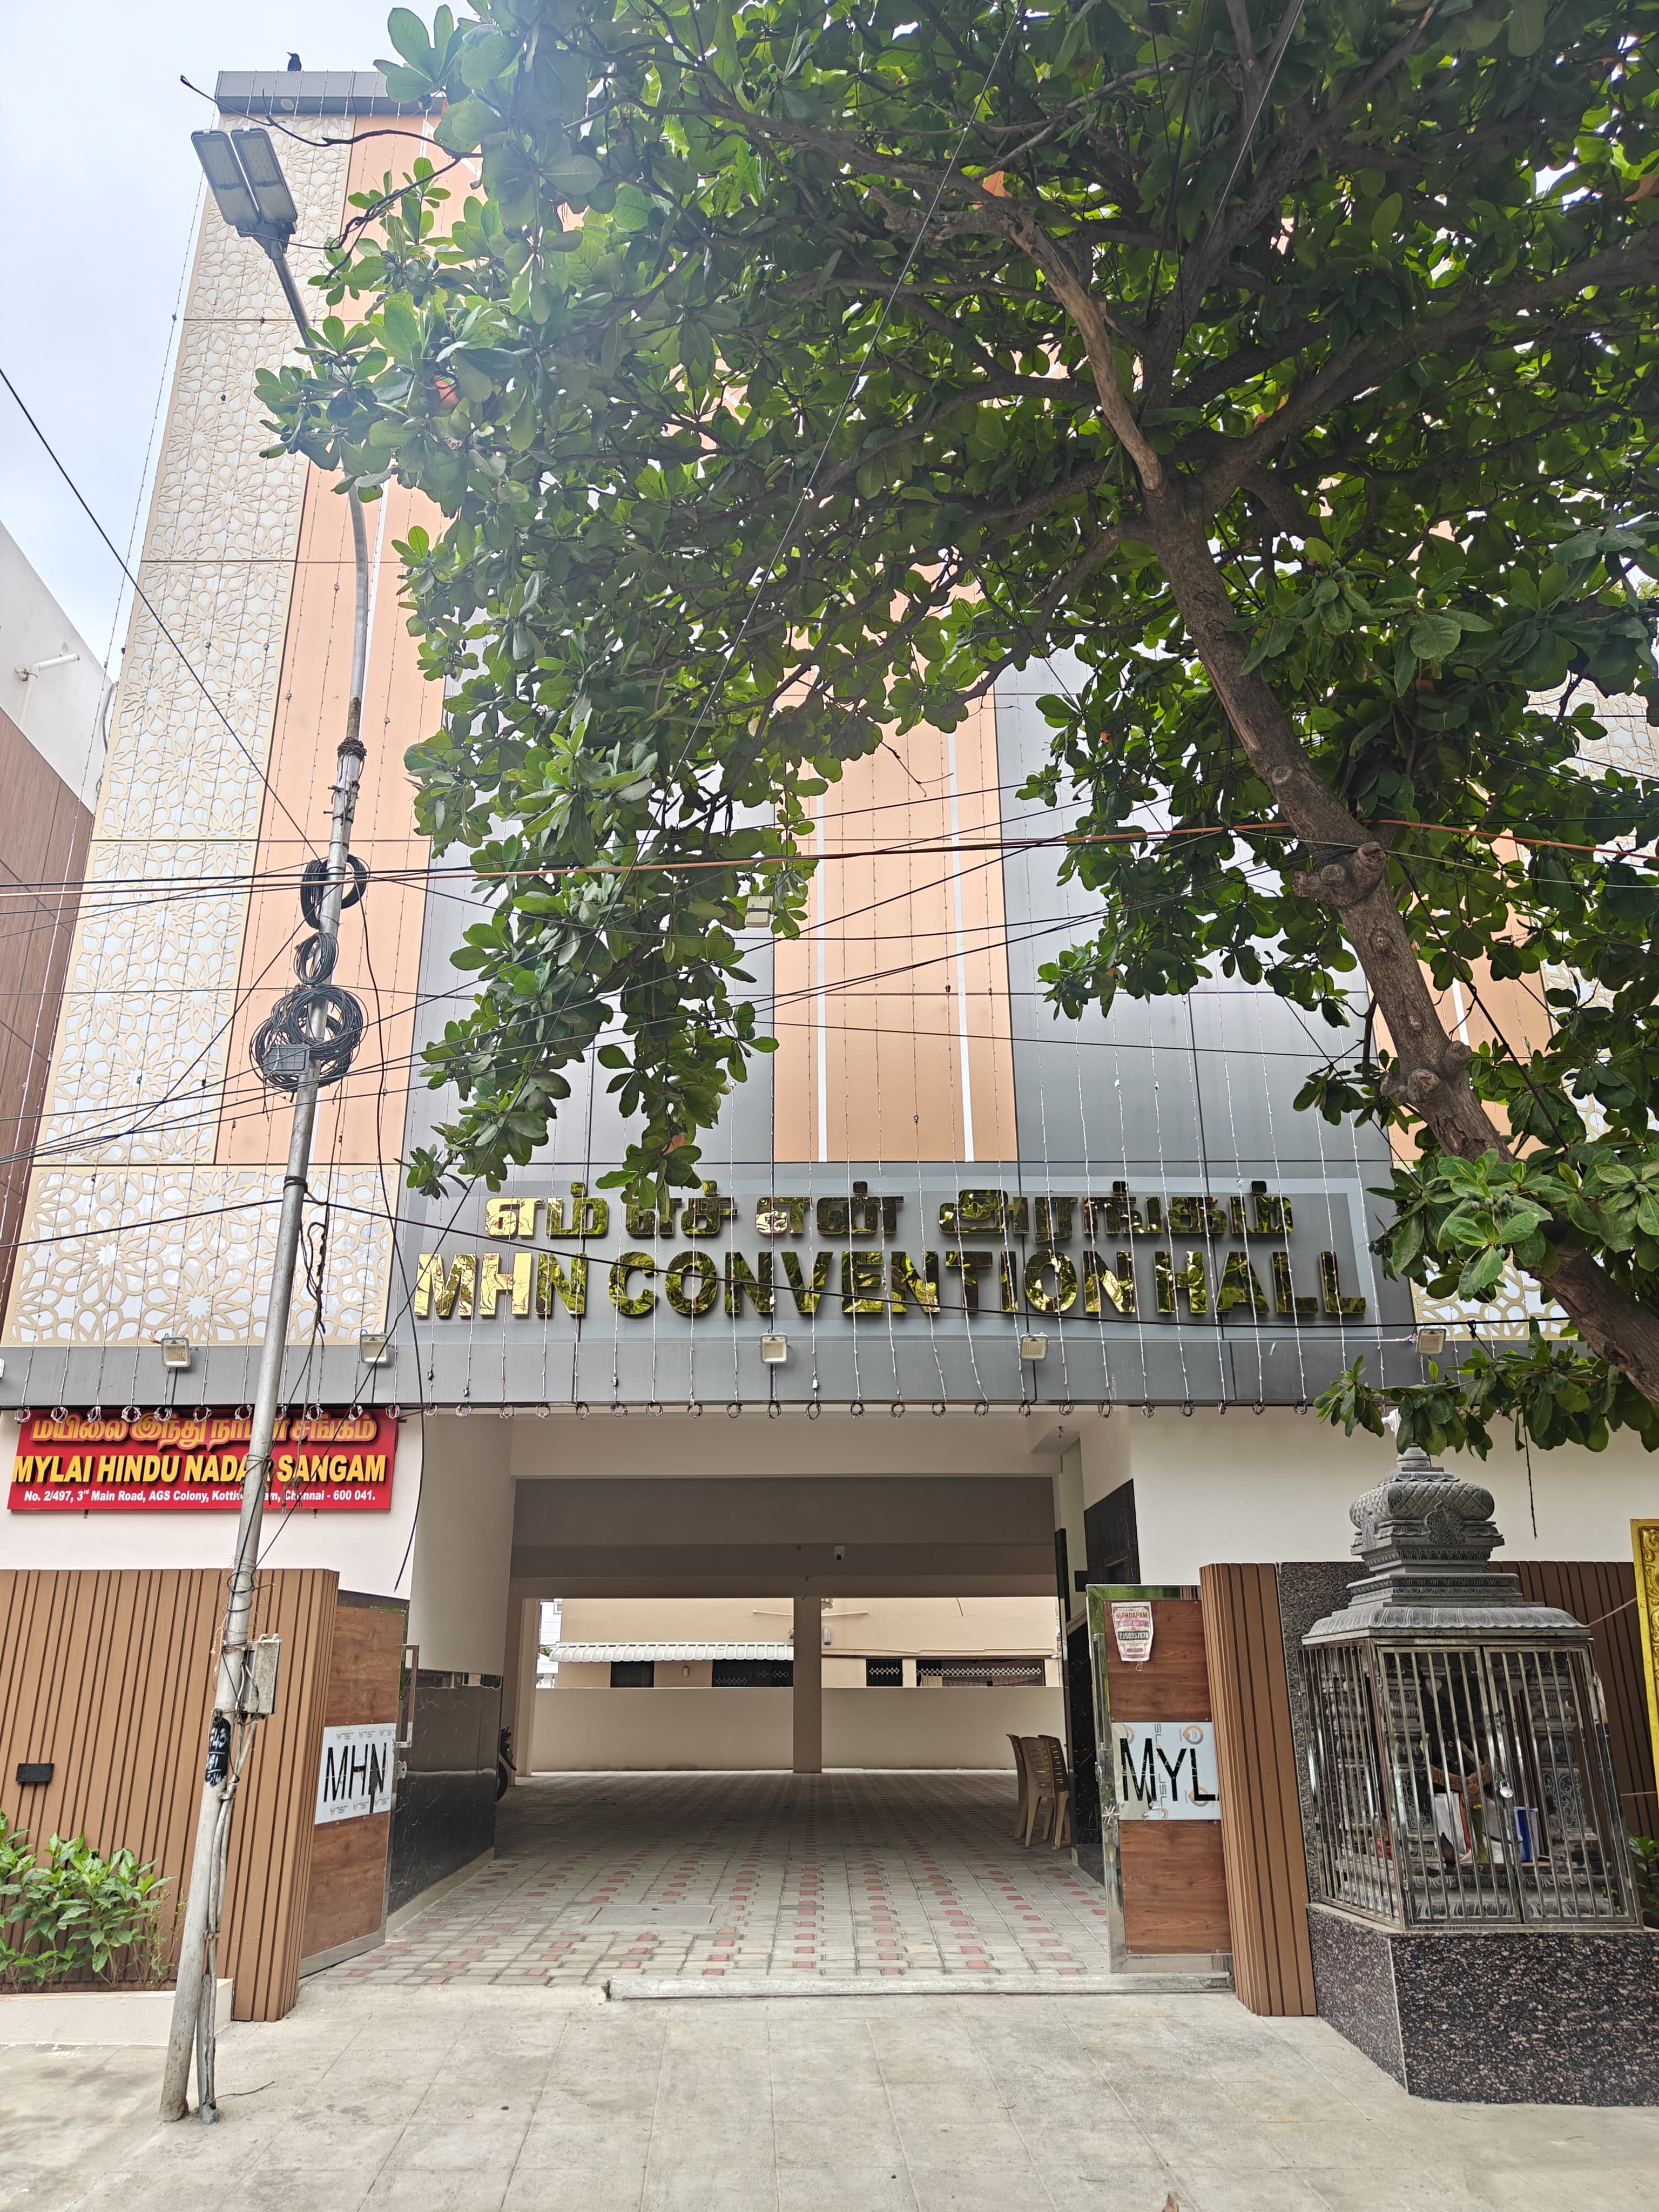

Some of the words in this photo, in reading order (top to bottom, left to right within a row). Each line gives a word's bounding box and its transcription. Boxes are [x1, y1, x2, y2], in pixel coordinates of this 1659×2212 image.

[485, 1182, 609, 1236] எம்
[756, 1181, 903, 1235] என்
[939, 1181, 1293, 1243] அரங்கம்
[414, 1252, 586, 1317] MHN
[608, 1249, 1136, 1317] CONVENTION
[1155, 1251, 1366, 1313] HALL
[32, 1413, 128, 1440] மயிலை
[132, 1412, 206, 1448] இந்து
[12, 1455, 92, 1482] MYLAI
[97, 1455, 179, 1482] HINDU
[184, 1455, 271, 1482] NADA
[277, 1454, 386, 1482] SANGAM
[24, 1491, 41, 1501] No.
[43, 1491, 74, 1503] 2/497,
[77, 1489, 89, 1501] 3rd
[91, 1491, 115, 1501] Main
[118, 1491, 146, 1503] Road,
[149, 1491, 170, 1501] AGS
[173, 1491, 210, 1503] Colony,
[333, 1490, 352, 1501] 600
[354, 1490, 376, 1501] 041.
[323, 1742, 387, 1803] MHN
[1120, 1738, 1219, 1801] MYL
